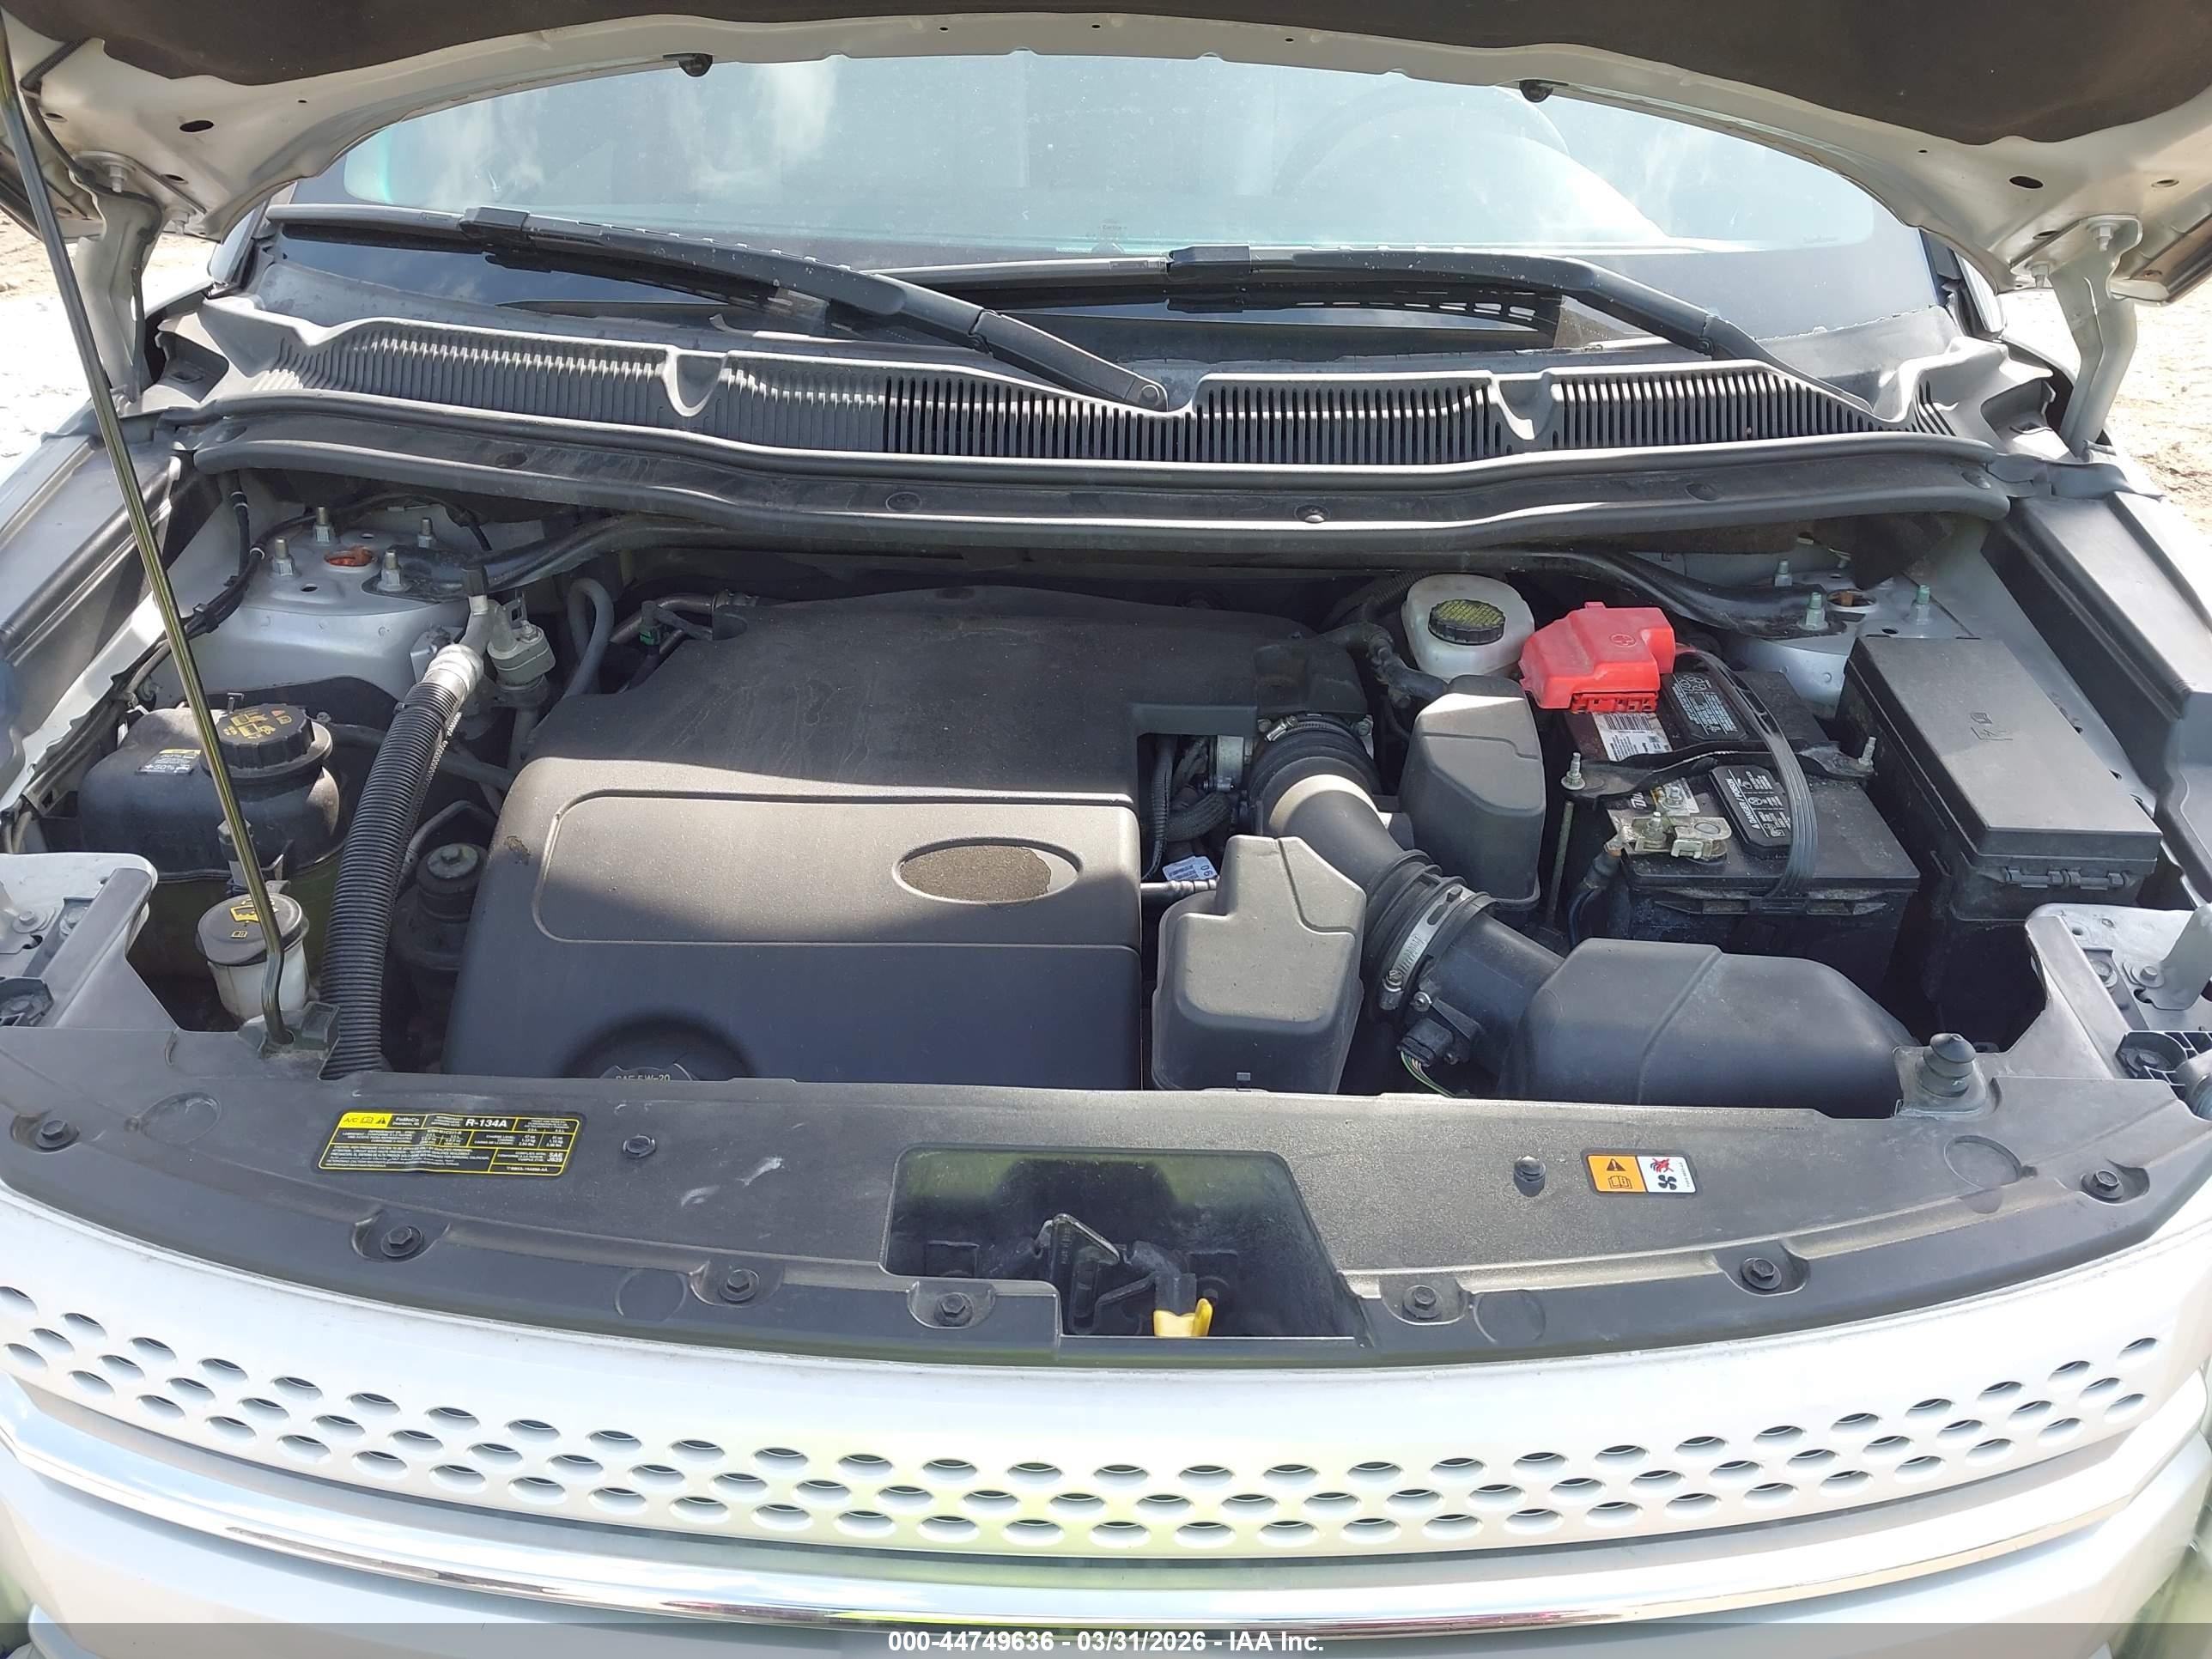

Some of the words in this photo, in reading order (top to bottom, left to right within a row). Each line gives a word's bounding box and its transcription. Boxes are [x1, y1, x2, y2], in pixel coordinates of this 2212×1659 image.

[1724, 778, 1743, 798] POISON
[1738, 801, 1758, 824] DANGER
[465, 1118, 507, 1128] R-134A
